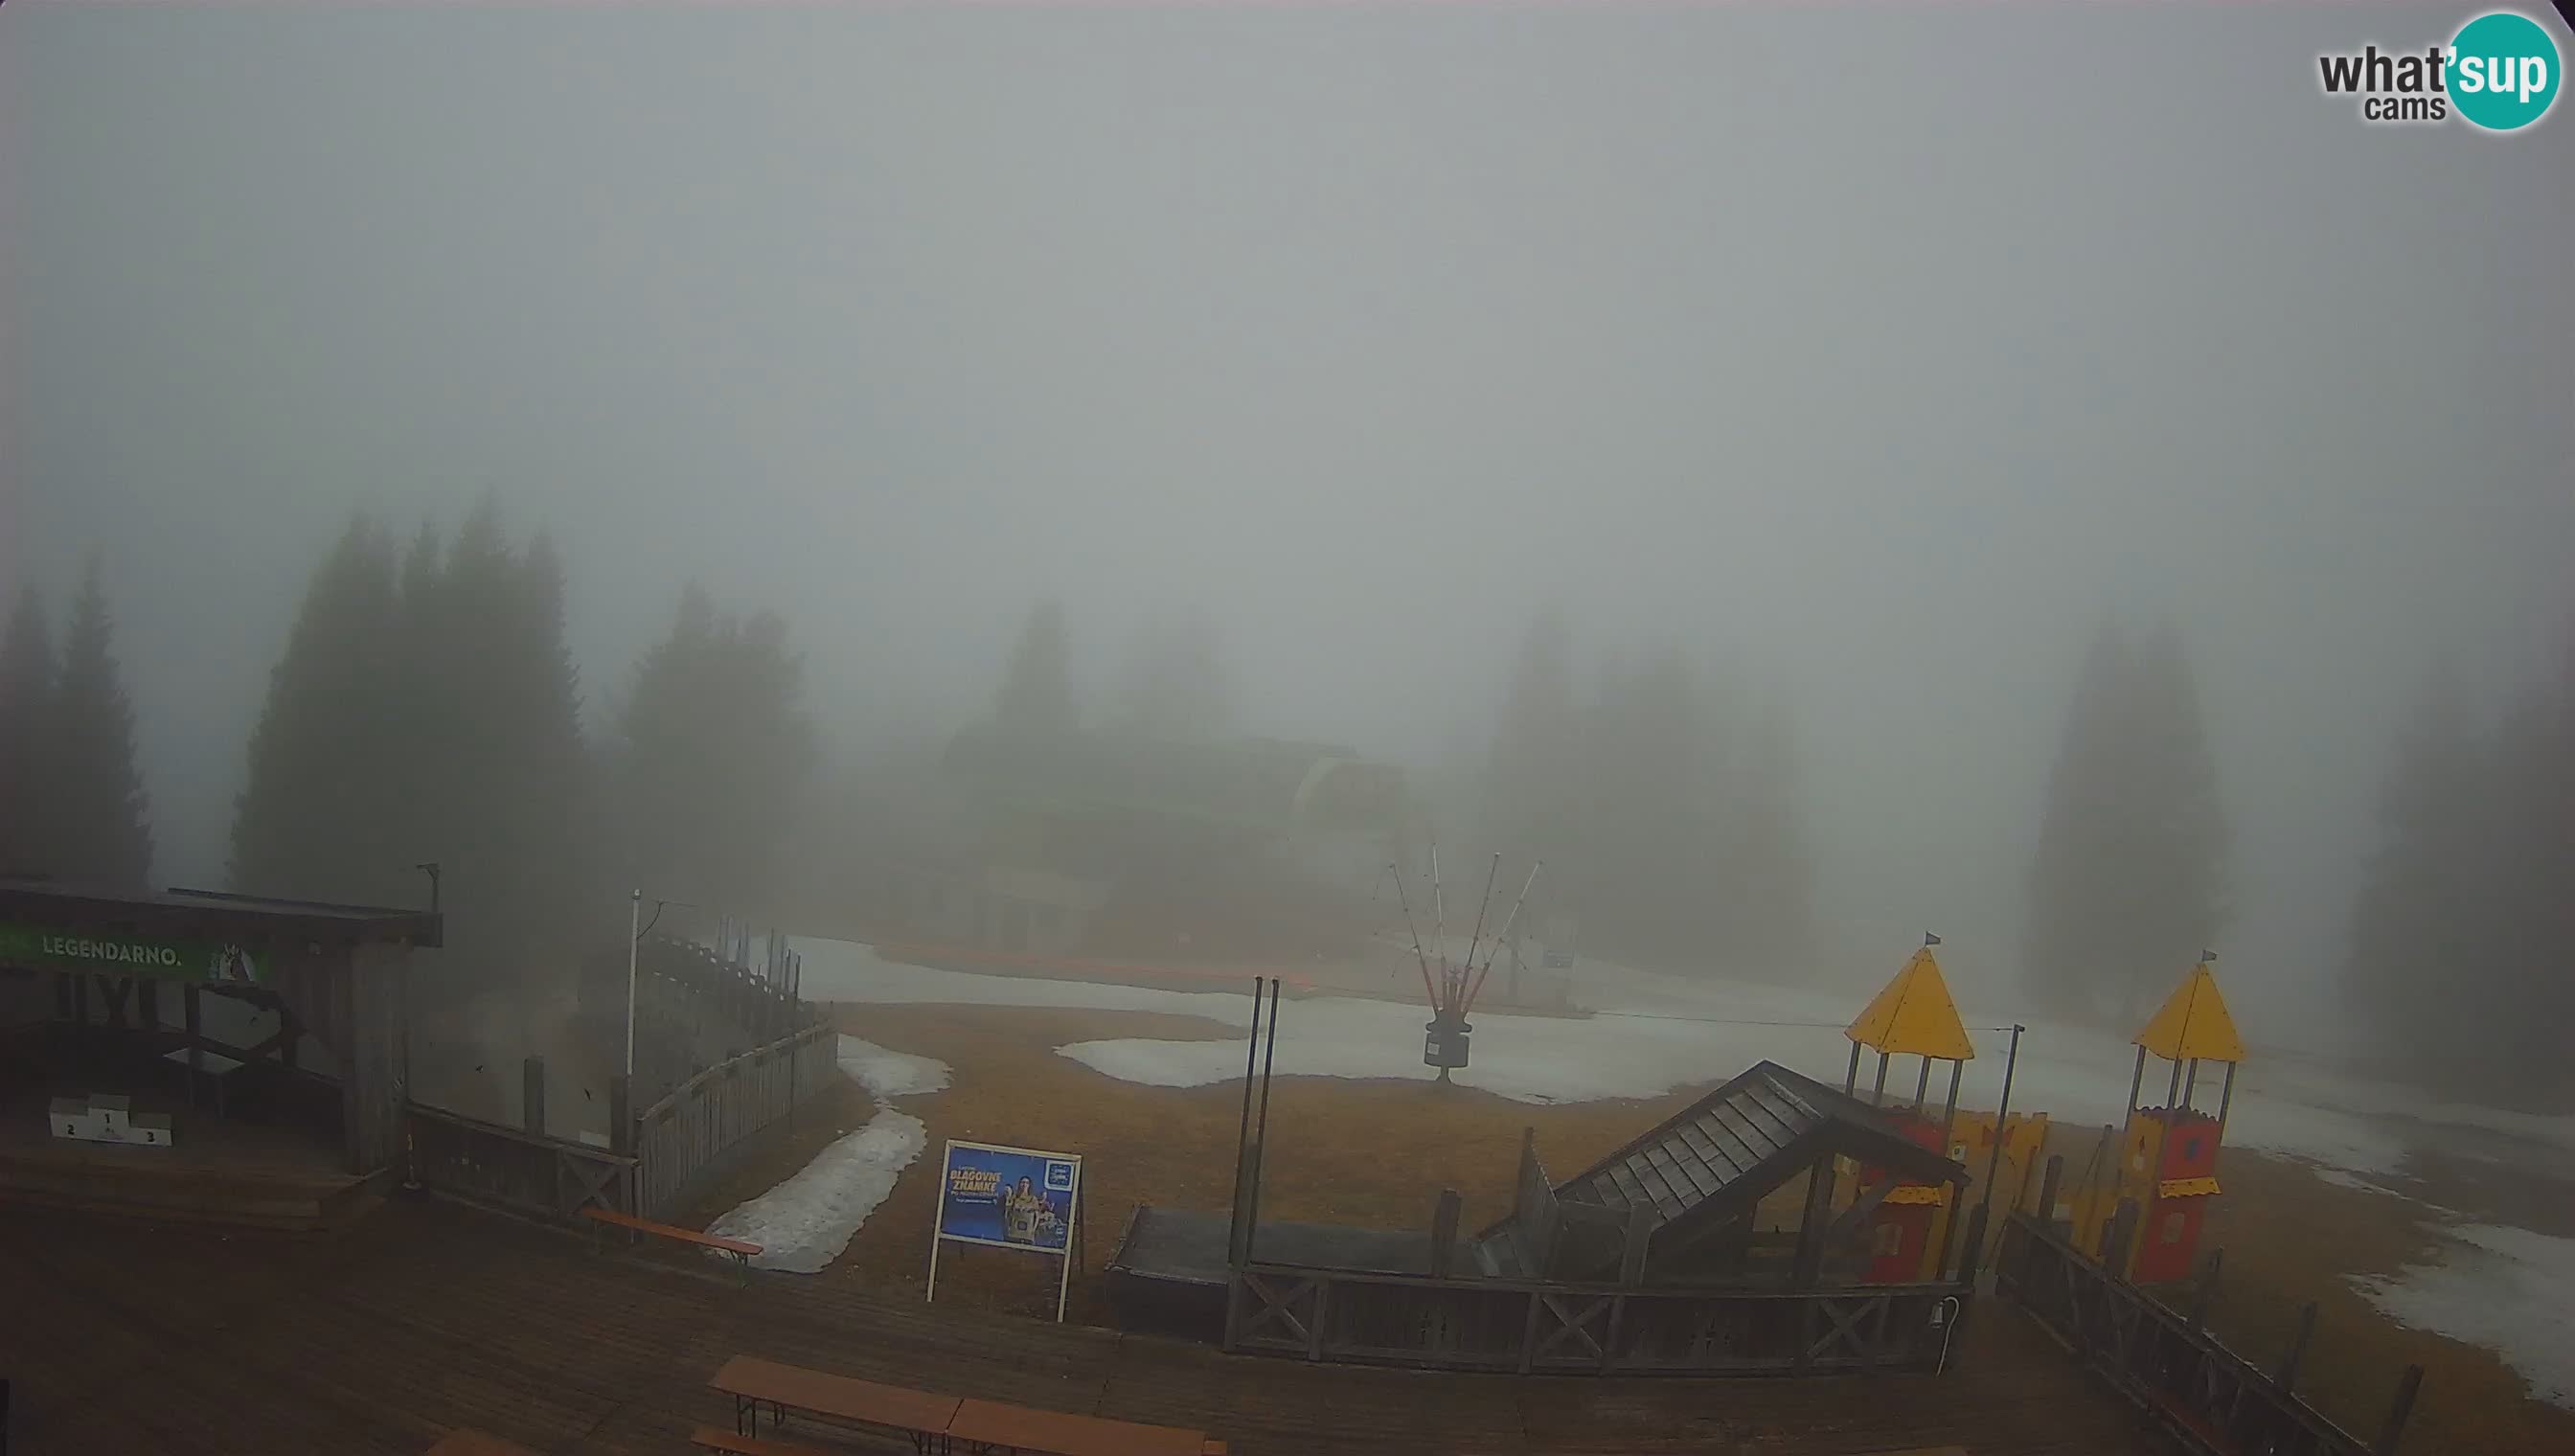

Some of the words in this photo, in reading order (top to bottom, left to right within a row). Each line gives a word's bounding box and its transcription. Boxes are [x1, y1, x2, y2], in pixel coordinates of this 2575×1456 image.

[42, 935, 182, 967] LEGENDARNO.
[104, 1113, 111, 1124] 1
[67, 1124, 75, 1135] 2
[147, 1131, 155, 1143] 3
[950, 1170, 1003, 1182] BLAGOVNE
[953, 1180, 997, 1192] ZNAMKE
